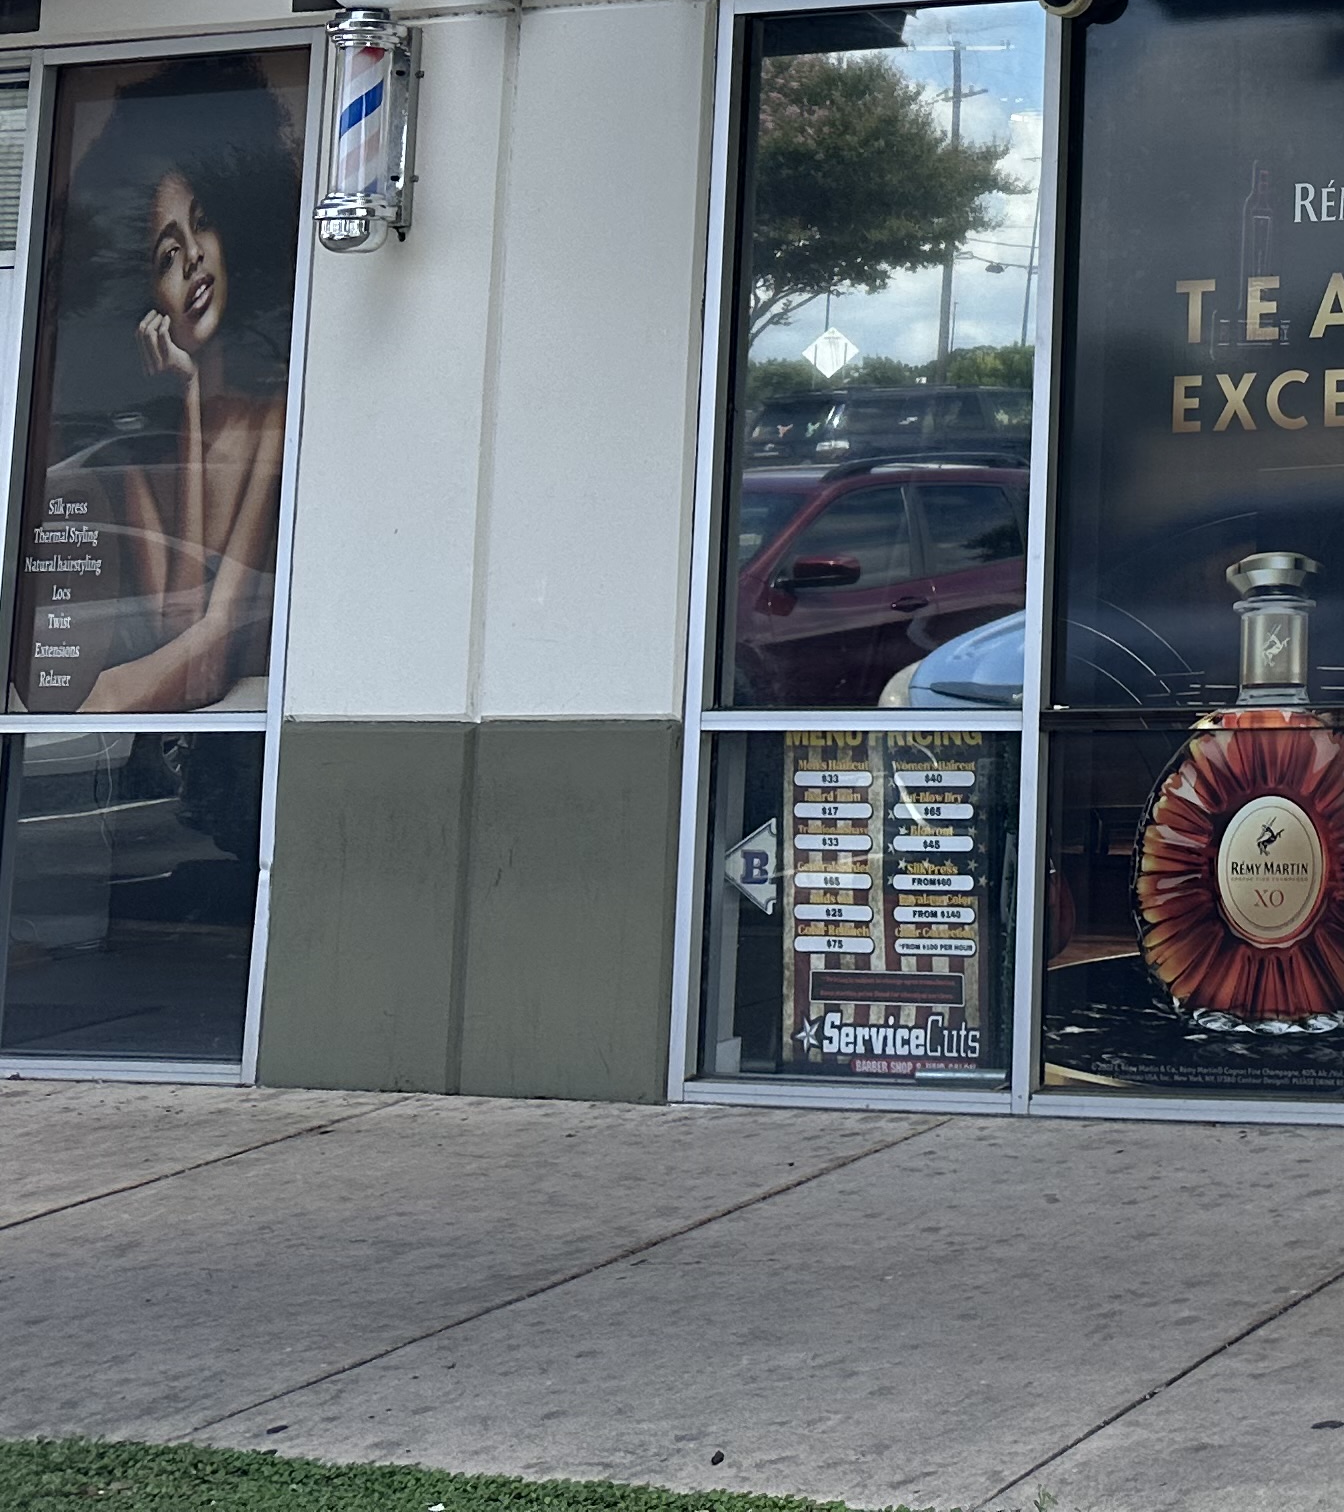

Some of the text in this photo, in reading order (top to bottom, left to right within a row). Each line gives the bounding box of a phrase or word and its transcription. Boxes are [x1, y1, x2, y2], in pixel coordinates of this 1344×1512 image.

[49, 498, 88, 518] Silk press
[34, 526, 98, 547] Thermal Styling
[25, 555, 102, 576] Natural hairstyling
[52, 585, 71, 601] Locs
[48, 613, 71, 629] Twist
[35, 641, 79, 658] Extensions
[39, 670, 70, 687] Relaxer
[1231, 860, 1308, 875] RÉMY MARTIN
[1254, 889, 1284, 907] XO
[822, 1012, 981, 1058] ServiceCuts
[856, 1060, 888, 1073] BARBER
[890, 1062, 913, 1074] SHOP
